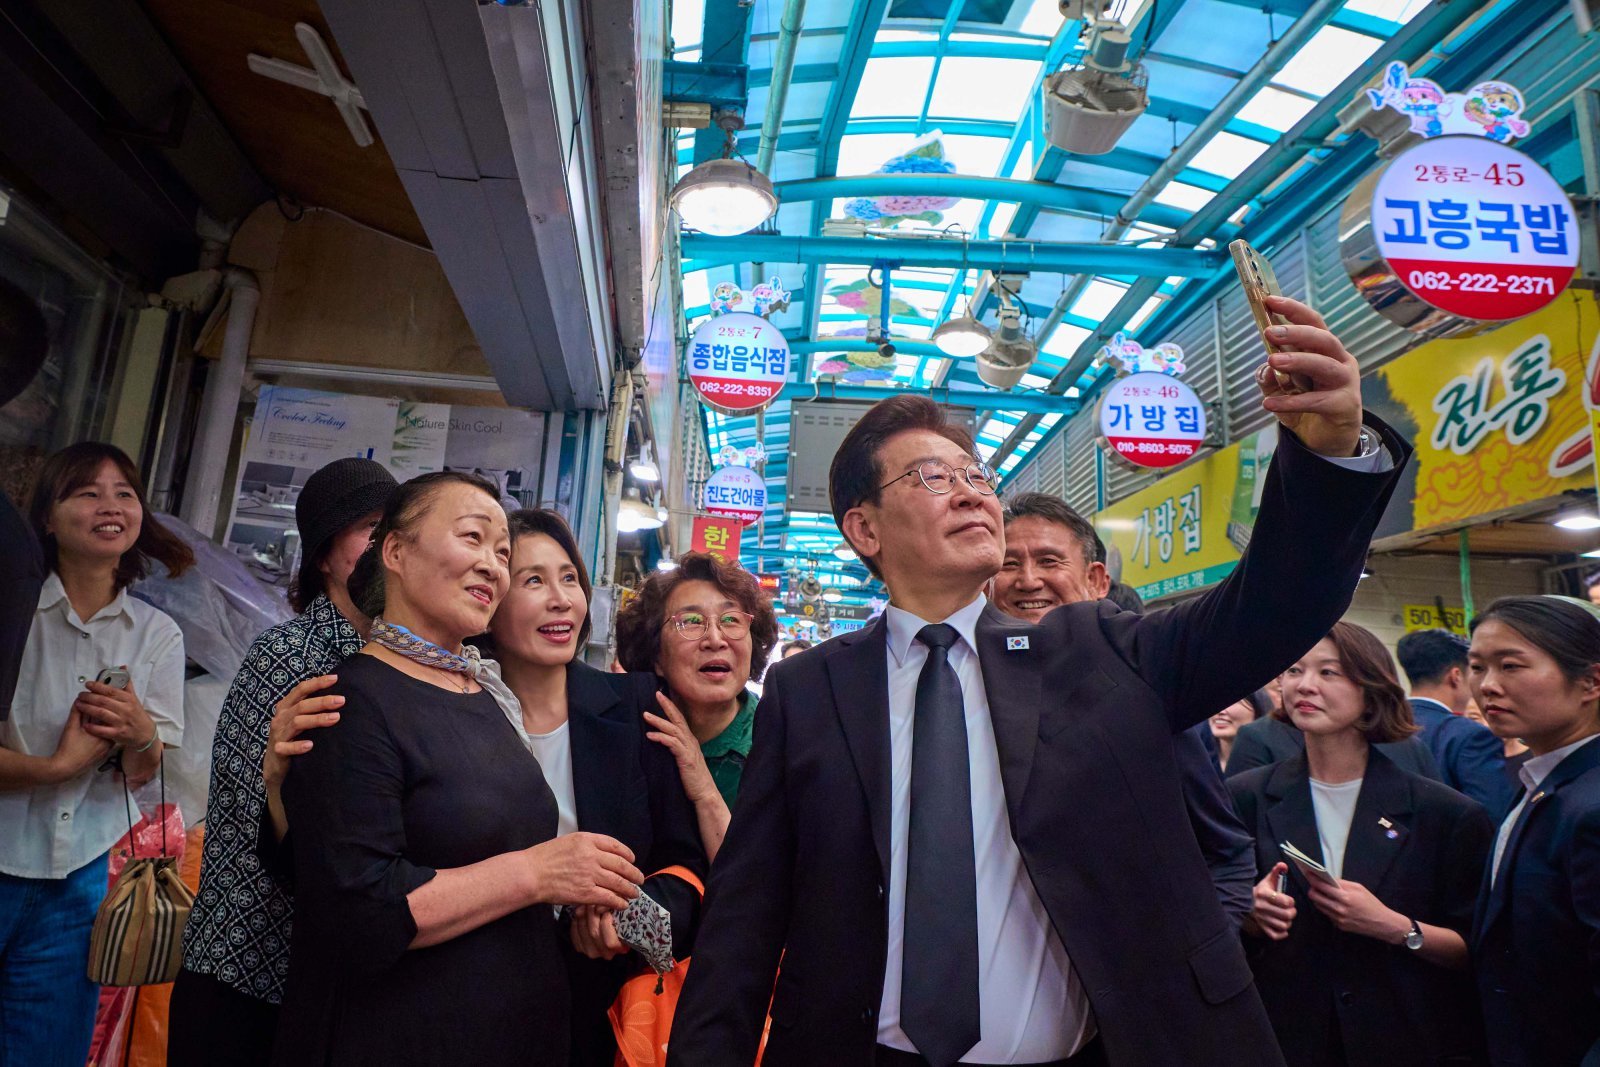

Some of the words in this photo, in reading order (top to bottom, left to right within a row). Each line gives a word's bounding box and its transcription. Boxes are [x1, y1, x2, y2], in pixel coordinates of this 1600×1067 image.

[1414, 162, 1526, 188] 2통로-45
[1383, 196, 1569, 256] 고흥국밥
[1408, 269, 1556, 296] 062-222-2371
[718, 325, 763, 340] 2통로-7
[692, 342, 787, 377] 종합음식점
[700, 381, 772, 397] 062-222-8351
[1433, 336, 1564, 452] 전통
[272, 405, 308, 423] Coolest
[309, 411, 346, 430] Feeling
[405, 415, 446, 430] Nature
[448, 418, 472, 433] Skin
[473, 420, 502, 435] Cool
[1108, 403, 1200, 434] 가방집
[707, 485, 765, 507] 진도건어물
[1131, 484, 1202, 569] 가방집
